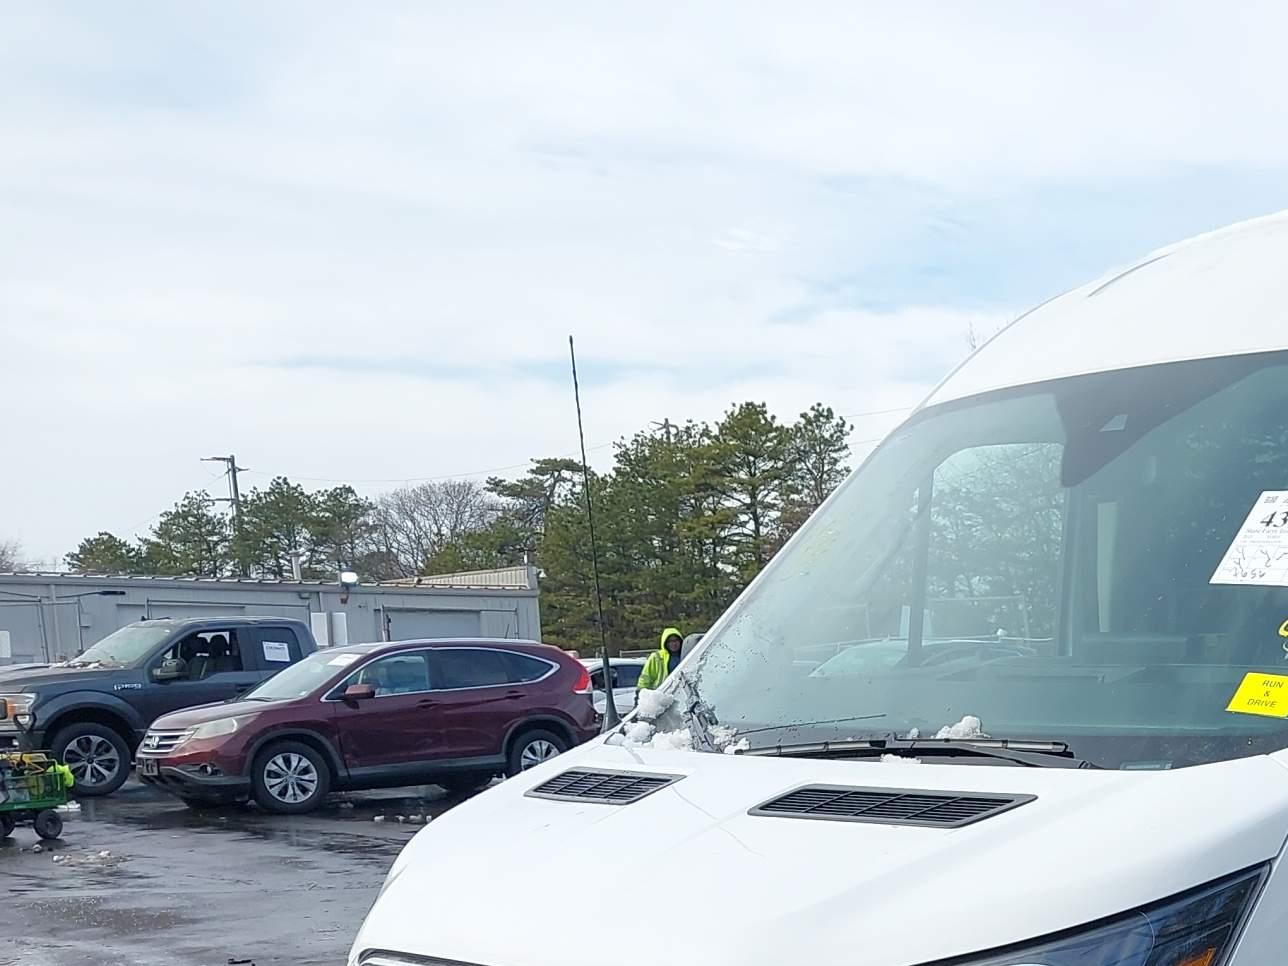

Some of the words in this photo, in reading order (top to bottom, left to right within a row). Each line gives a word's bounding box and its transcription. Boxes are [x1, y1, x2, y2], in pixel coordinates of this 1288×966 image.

[1262, 679, 1284, 689] RUN
[1263, 689, 1271, 697] &
[1247, 698, 1278, 708] DRIVE
